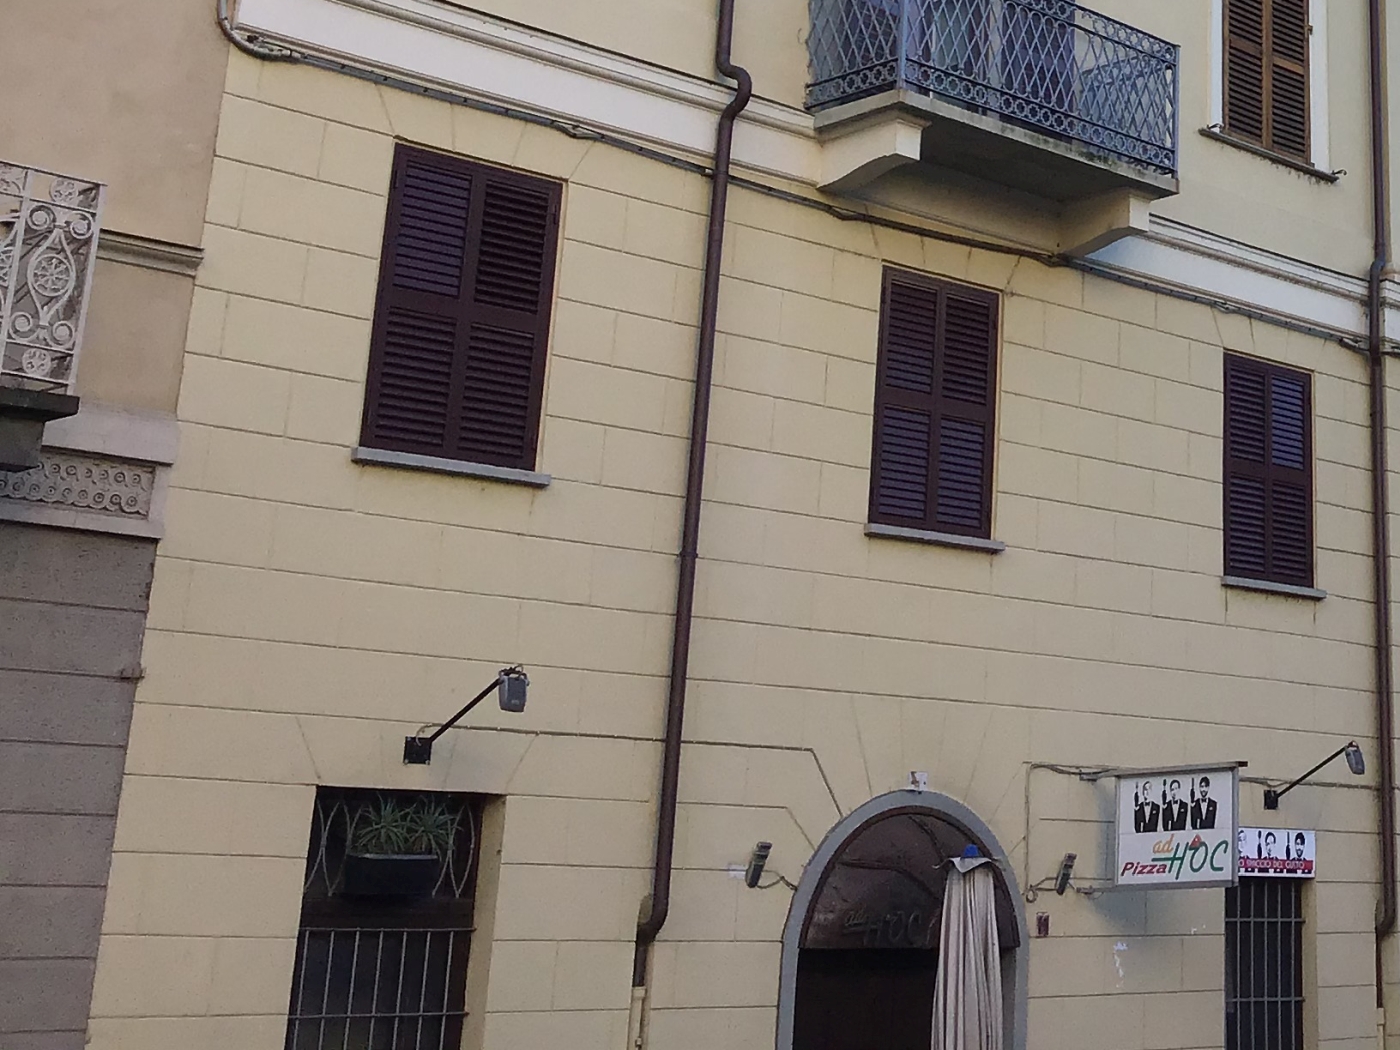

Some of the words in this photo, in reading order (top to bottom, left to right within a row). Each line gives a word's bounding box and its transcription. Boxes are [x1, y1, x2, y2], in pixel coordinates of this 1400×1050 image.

[1152, 833, 1175, 854] ad
[1120, 861, 1168, 877] Pizza
[1151, 839, 1230, 881] HOC
